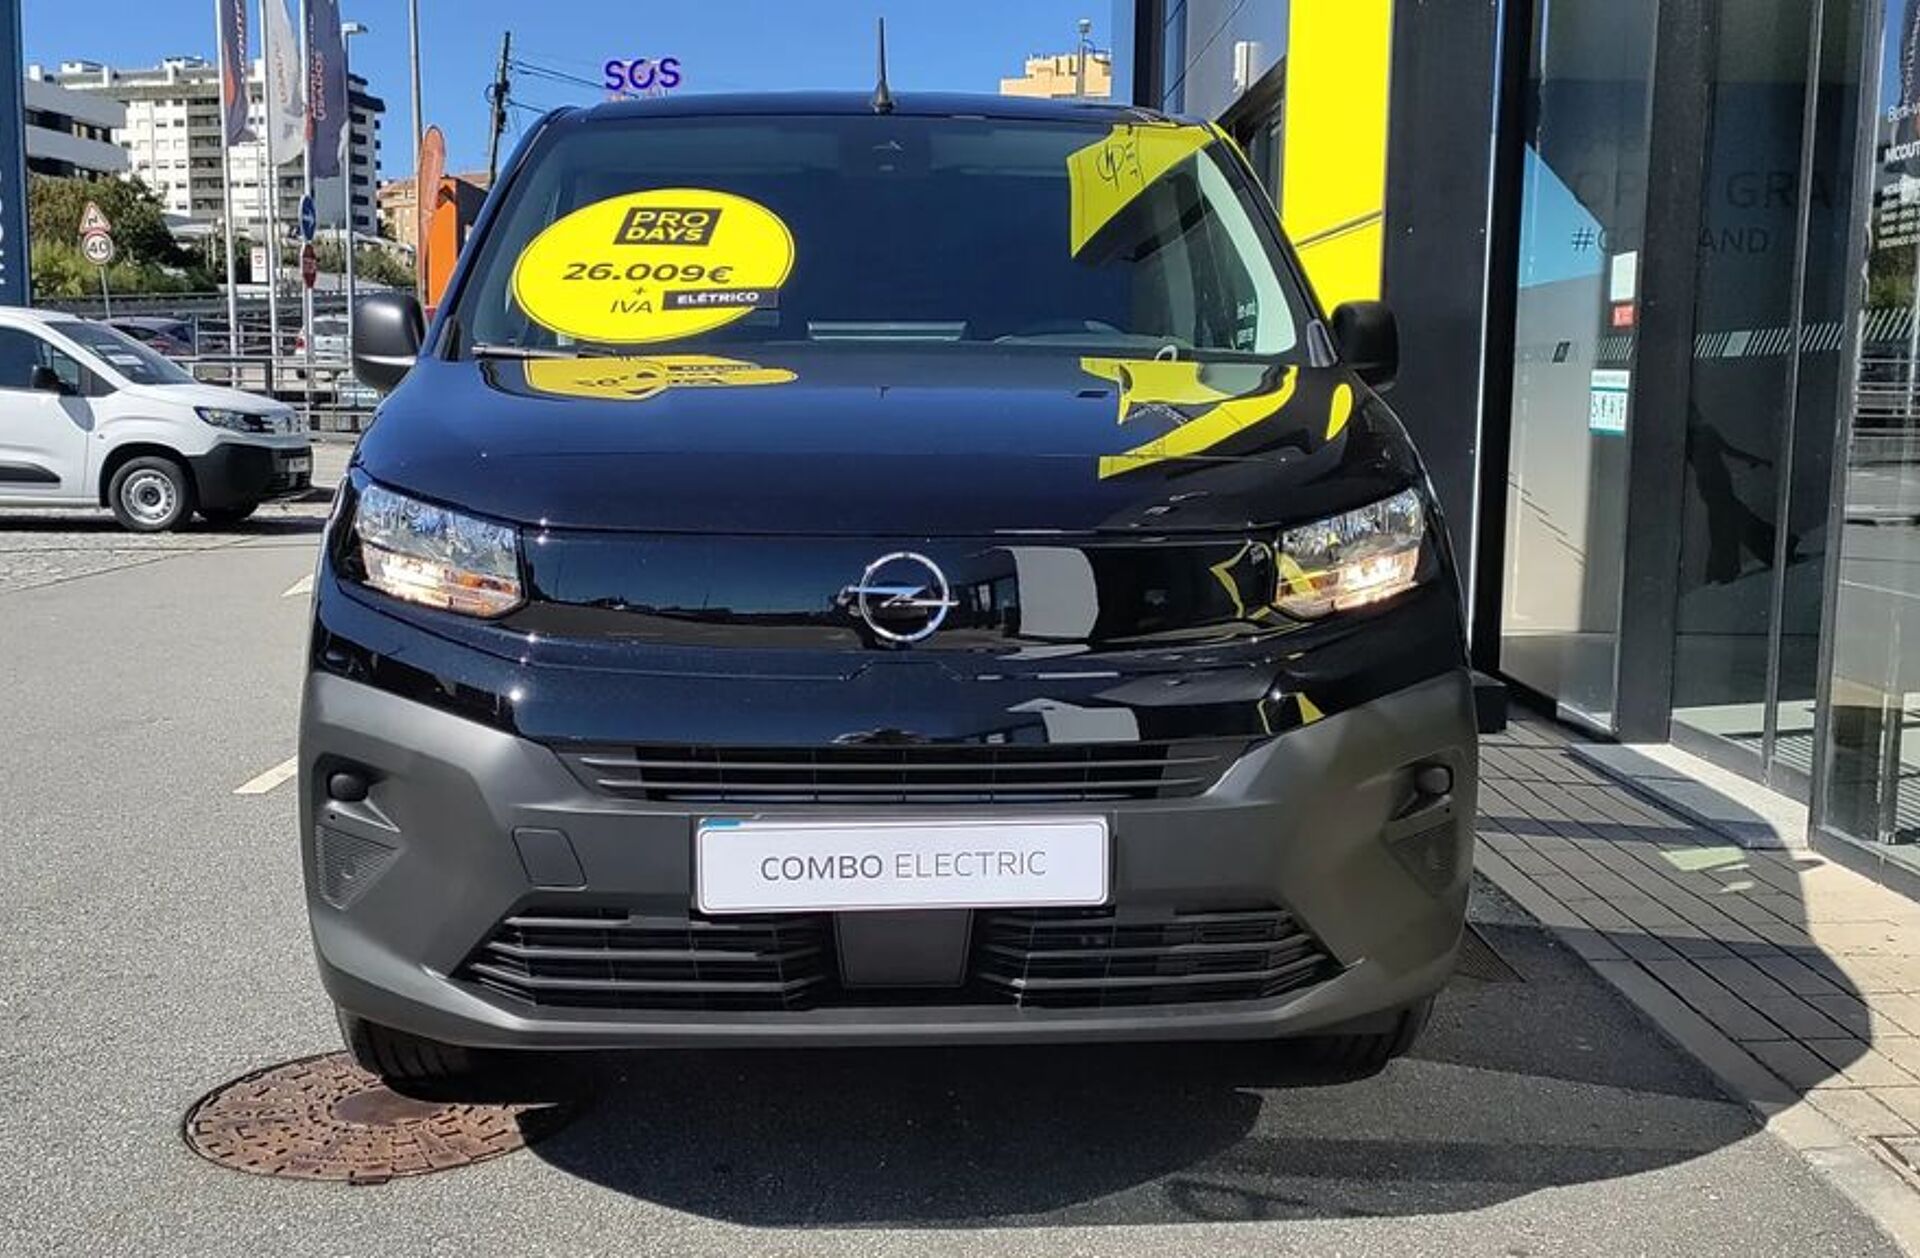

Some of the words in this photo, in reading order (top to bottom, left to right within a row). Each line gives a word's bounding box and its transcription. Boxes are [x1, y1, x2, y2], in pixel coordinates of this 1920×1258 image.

[604, 57, 681, 90] SOS
[630, 210, 710, 228] PRO
[625, 227, 704, 243] DAYS
[88, 240, 109, 254] 40
[562, 263, 735, 284] 26.009€
[610, 299, 654, 314] IVA
[760, 854, 883, 882] COMBO
[894, 850, 1048, 879] ELECTRIC
